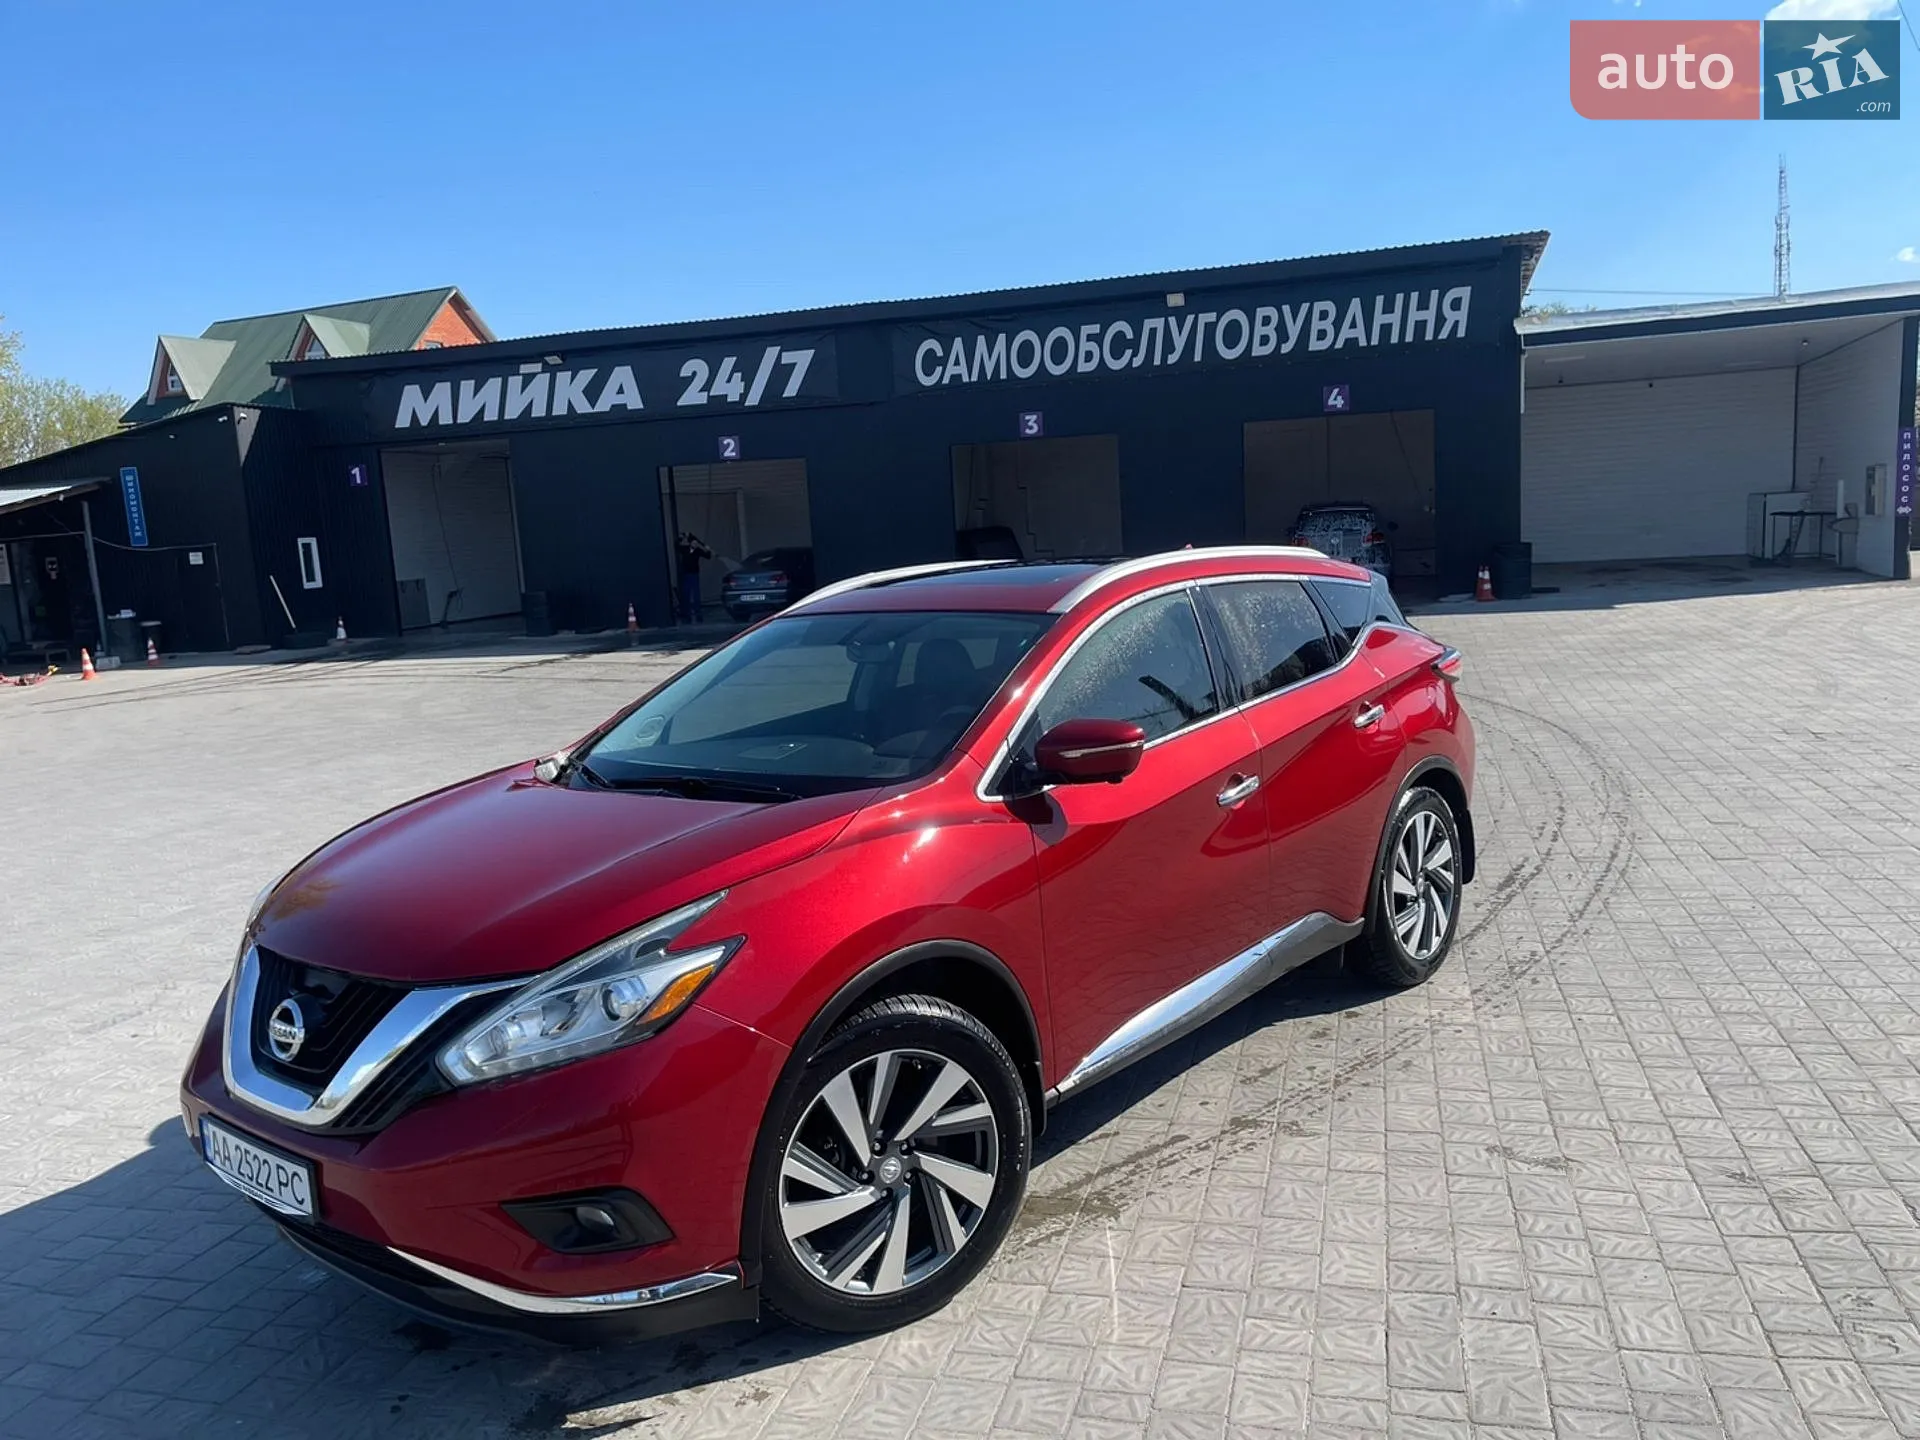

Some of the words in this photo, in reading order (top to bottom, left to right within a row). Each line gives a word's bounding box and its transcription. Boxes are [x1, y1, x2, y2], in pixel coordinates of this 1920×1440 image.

[914, 286, 1472, 387] САМООБСЛУГОВУВАННЯ
[394, 362, 643, 429] МИЙКА
[677, 346, 815, 408] 24/7
[1327, 387, 1345, 408] 4
[1024, 414, 1039, 435] 3
[722, 438, 736, 457] 2
[350, 466, 362, 485] 1
[235, 1144, 274, 1193] 2522
